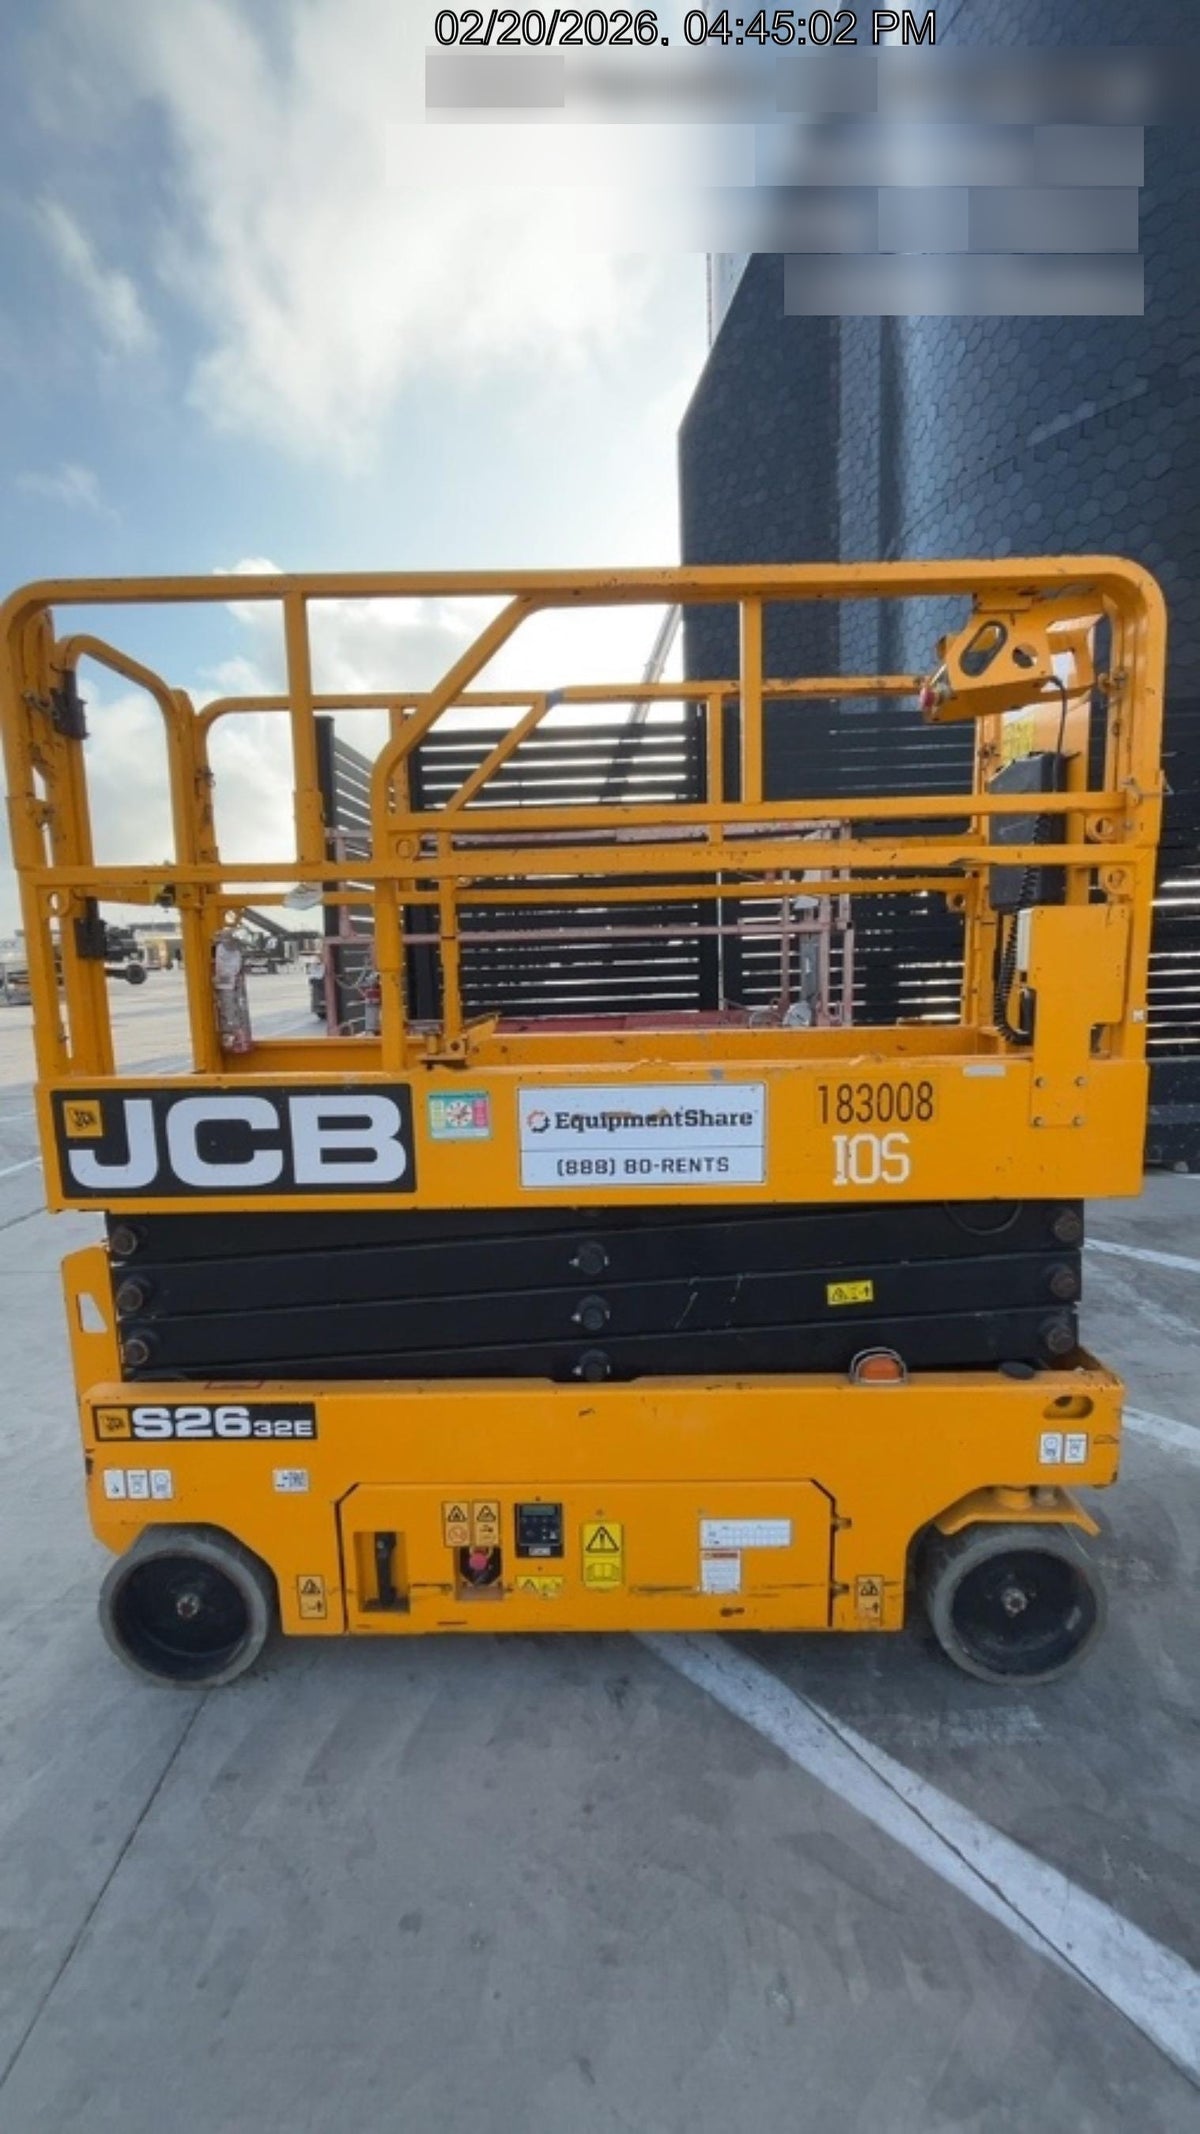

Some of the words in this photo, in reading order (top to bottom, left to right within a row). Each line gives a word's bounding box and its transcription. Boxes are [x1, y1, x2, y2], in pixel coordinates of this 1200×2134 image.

[818, 1081, 933, 1124] 183008
[554, 1108, 753, 1133] EquipmentShare
[68, 1094, 407, 1188] JCB
[557, 1158, 616, 1177] (888)
[624, 1157, 730, 1174] 80-RENTS
